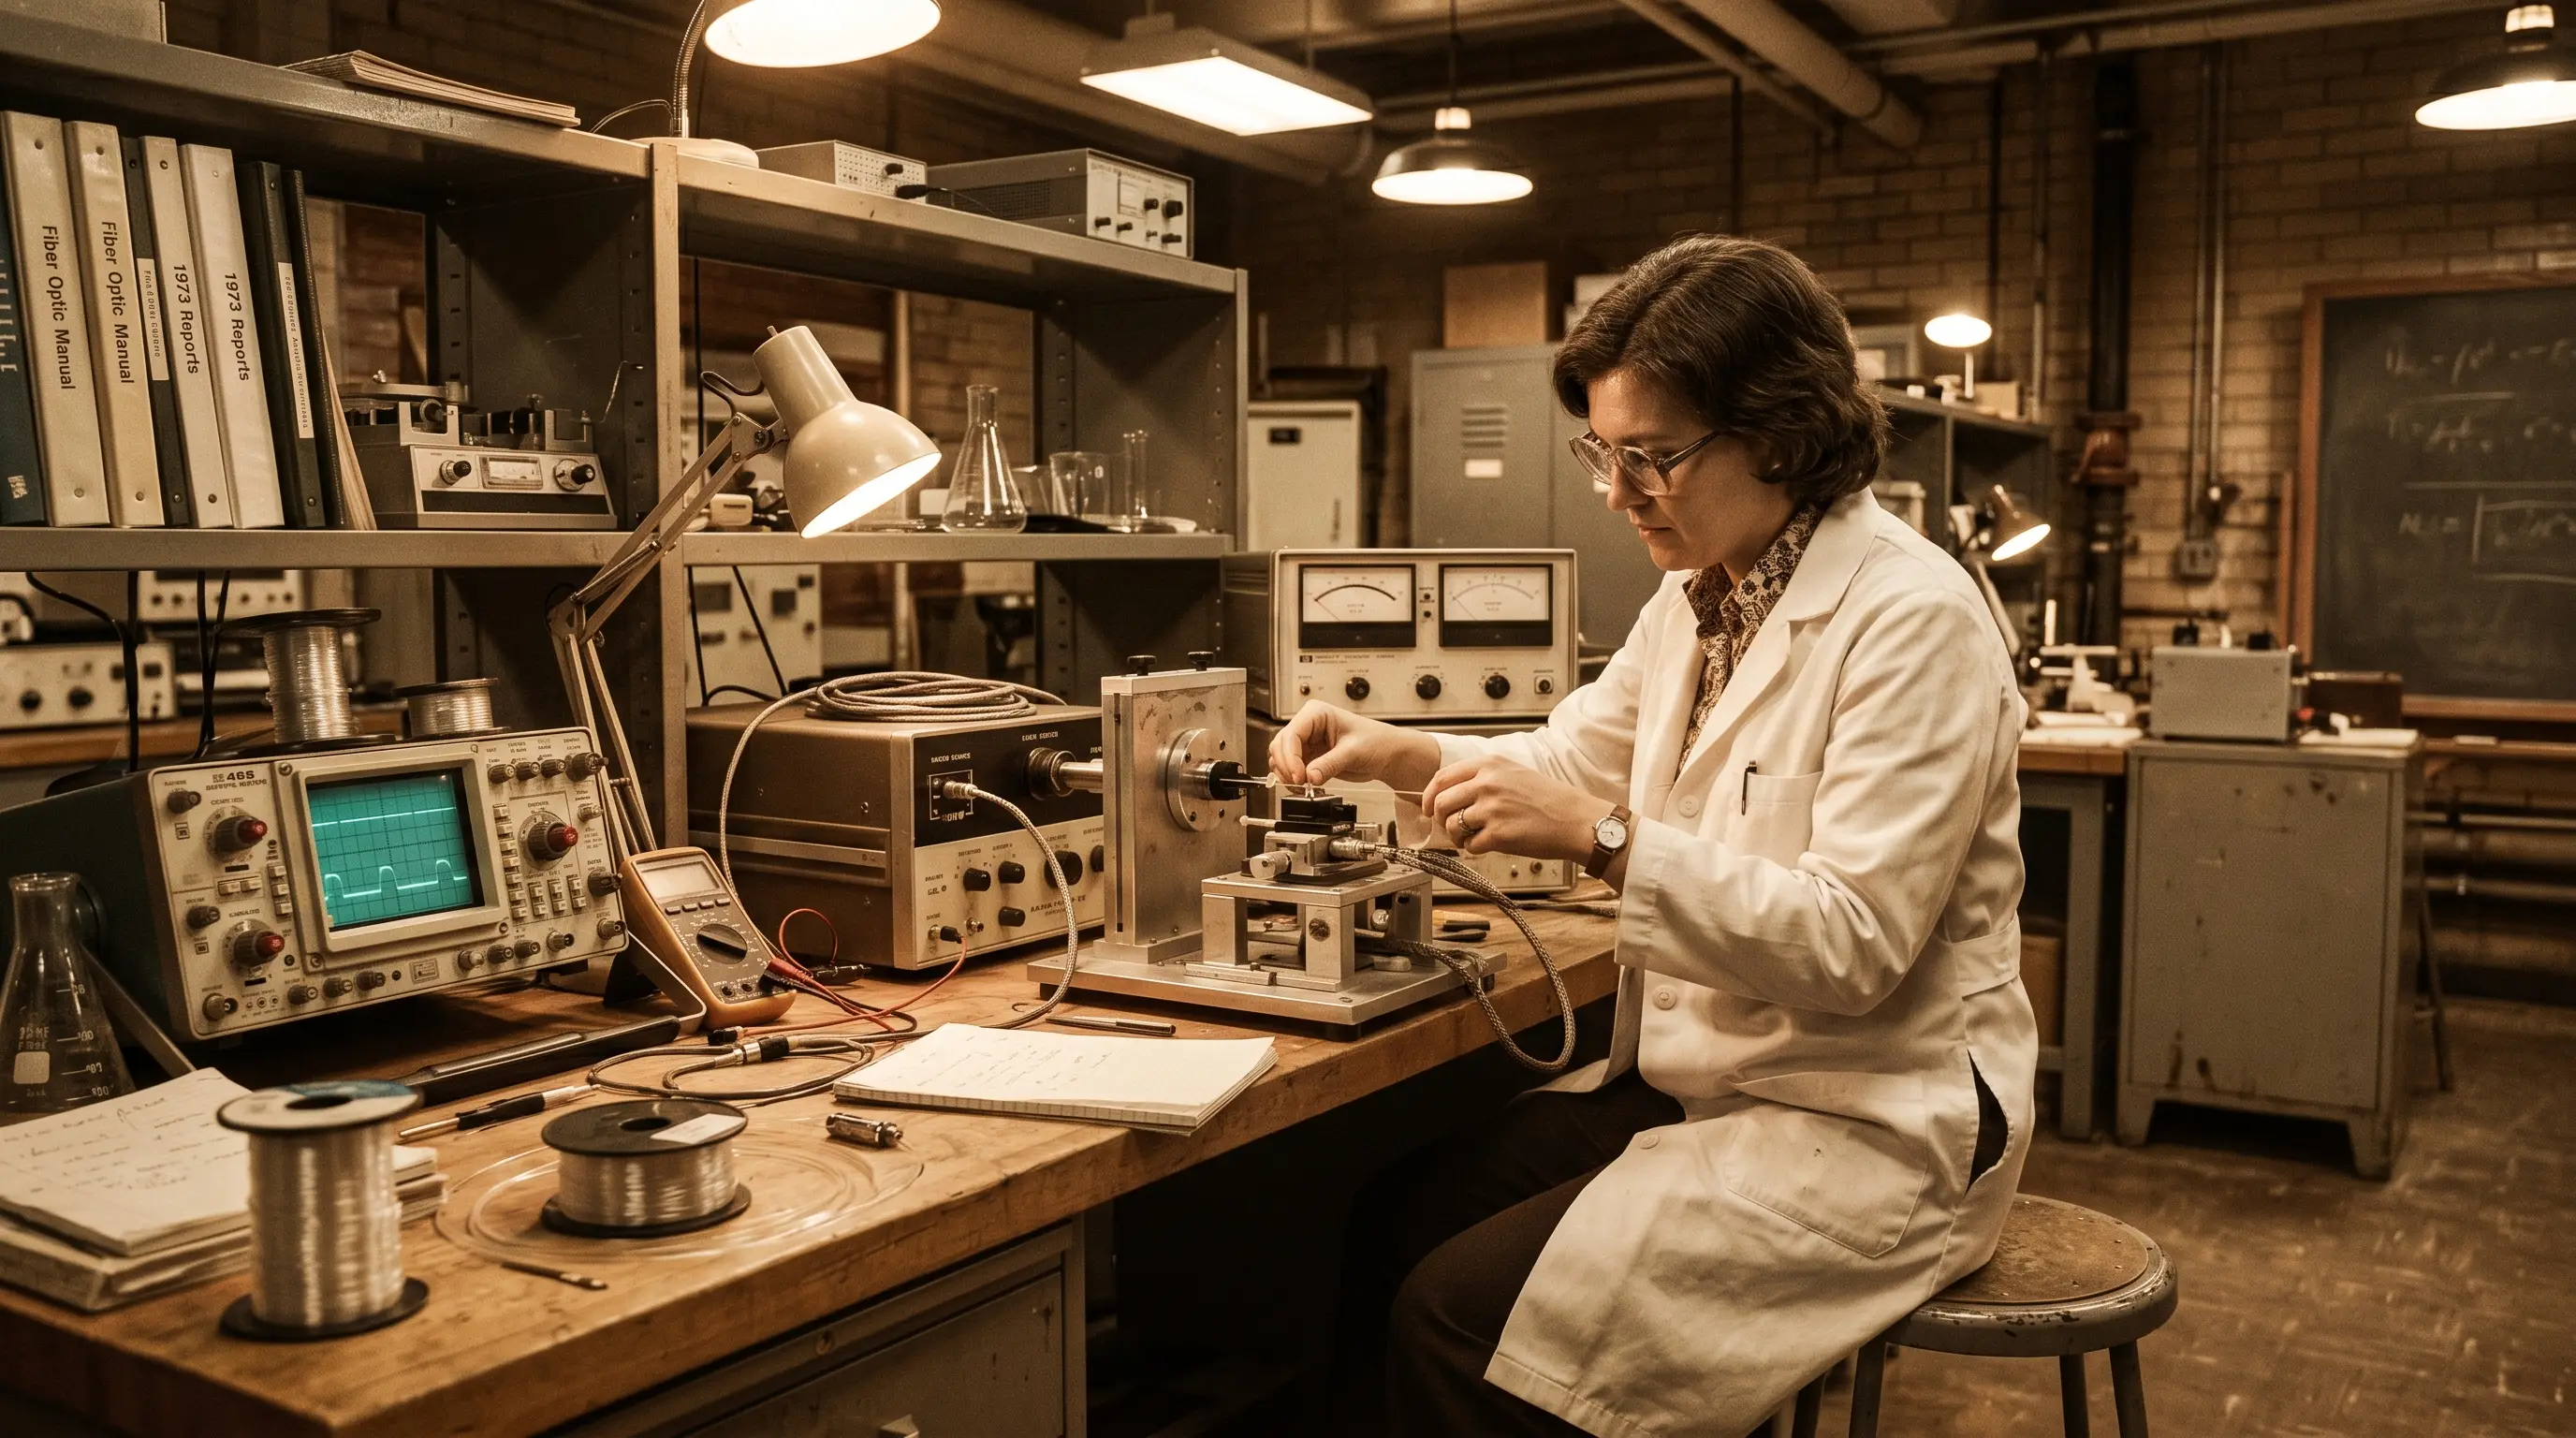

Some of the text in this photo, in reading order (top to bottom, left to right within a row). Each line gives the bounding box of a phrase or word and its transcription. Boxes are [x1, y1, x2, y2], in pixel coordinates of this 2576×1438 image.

[42, 225, 76, 389] Fiber Optic Manual
[101, 221, 134, 384] Fiber Optic Manual
[173, 264, 200, 374] 1973 Reports
[225, 272, 251, 381] 1973 Reports
